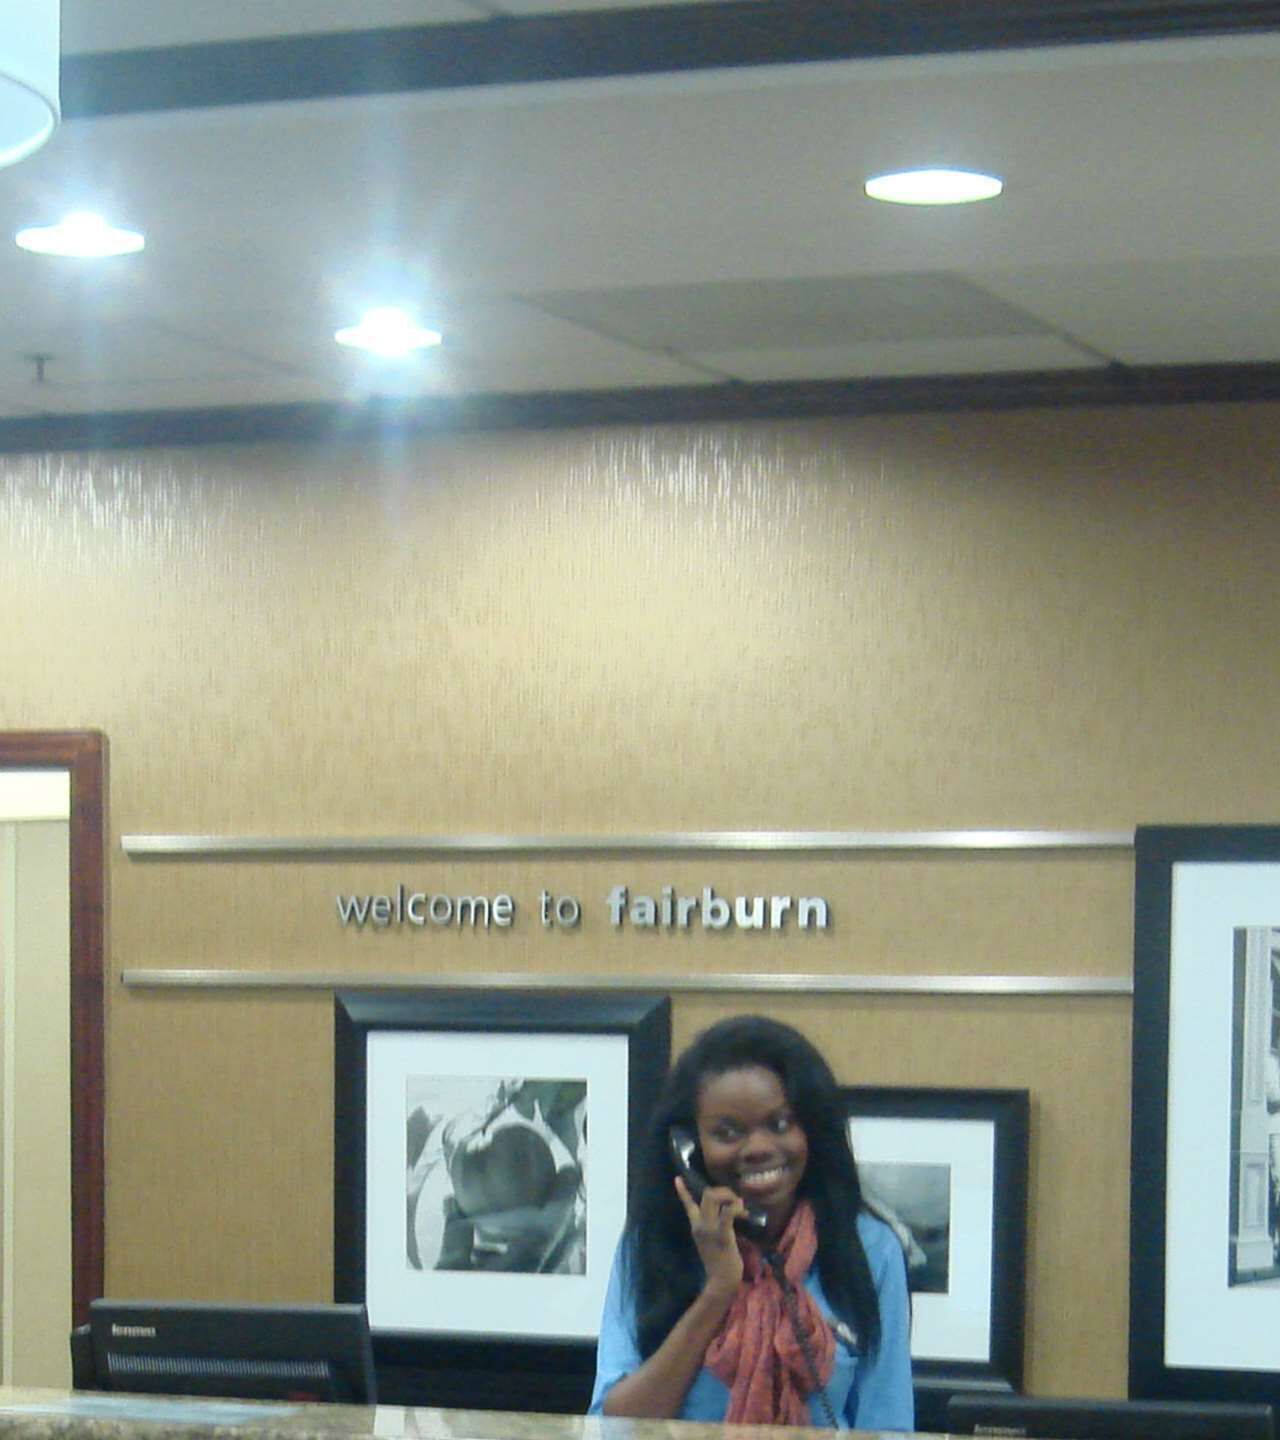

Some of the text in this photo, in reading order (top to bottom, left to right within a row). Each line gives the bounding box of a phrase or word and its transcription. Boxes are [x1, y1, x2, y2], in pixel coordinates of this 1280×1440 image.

[336, 884, 829, 929] welcome to fairburn
